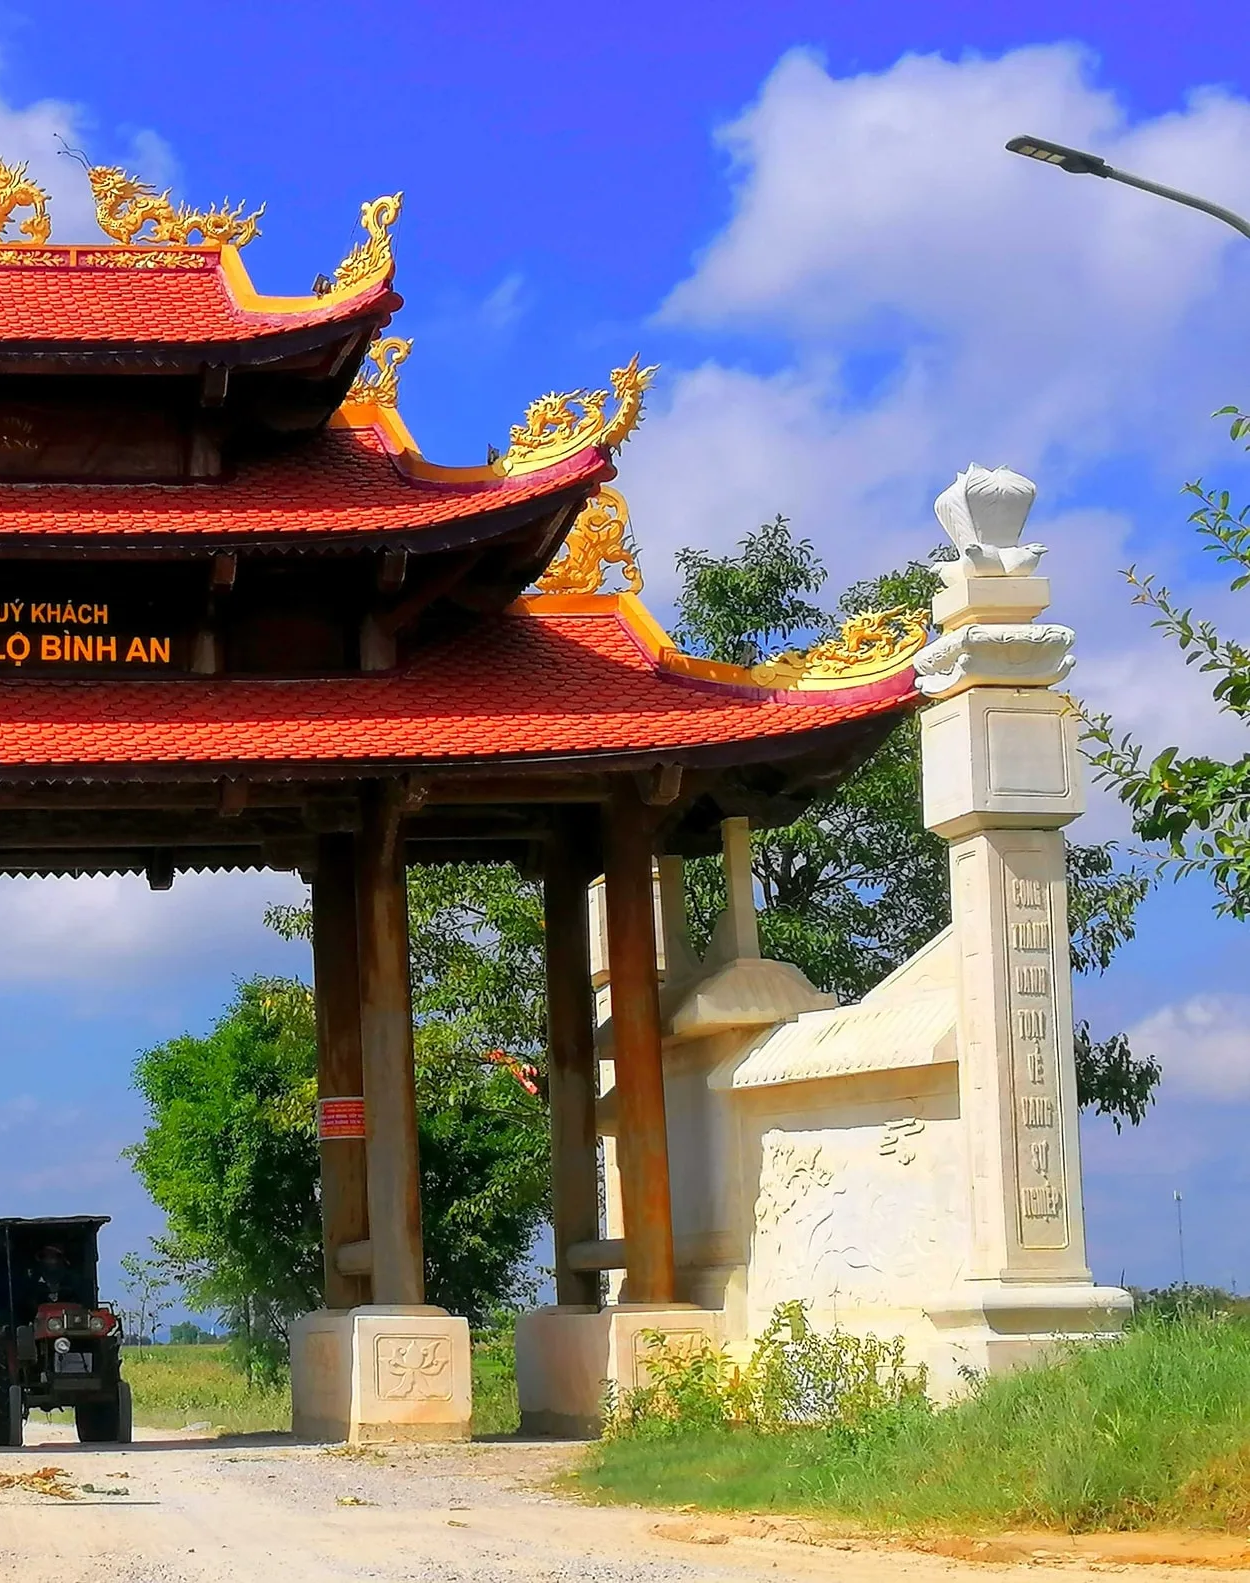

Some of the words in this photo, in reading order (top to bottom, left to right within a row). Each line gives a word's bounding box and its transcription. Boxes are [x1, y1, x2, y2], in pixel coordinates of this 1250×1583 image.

[31, 600, 108, 625] KHÁCH
[41, 629, 117, 662] BÌNH
[125, 637, 170, 663] AN
